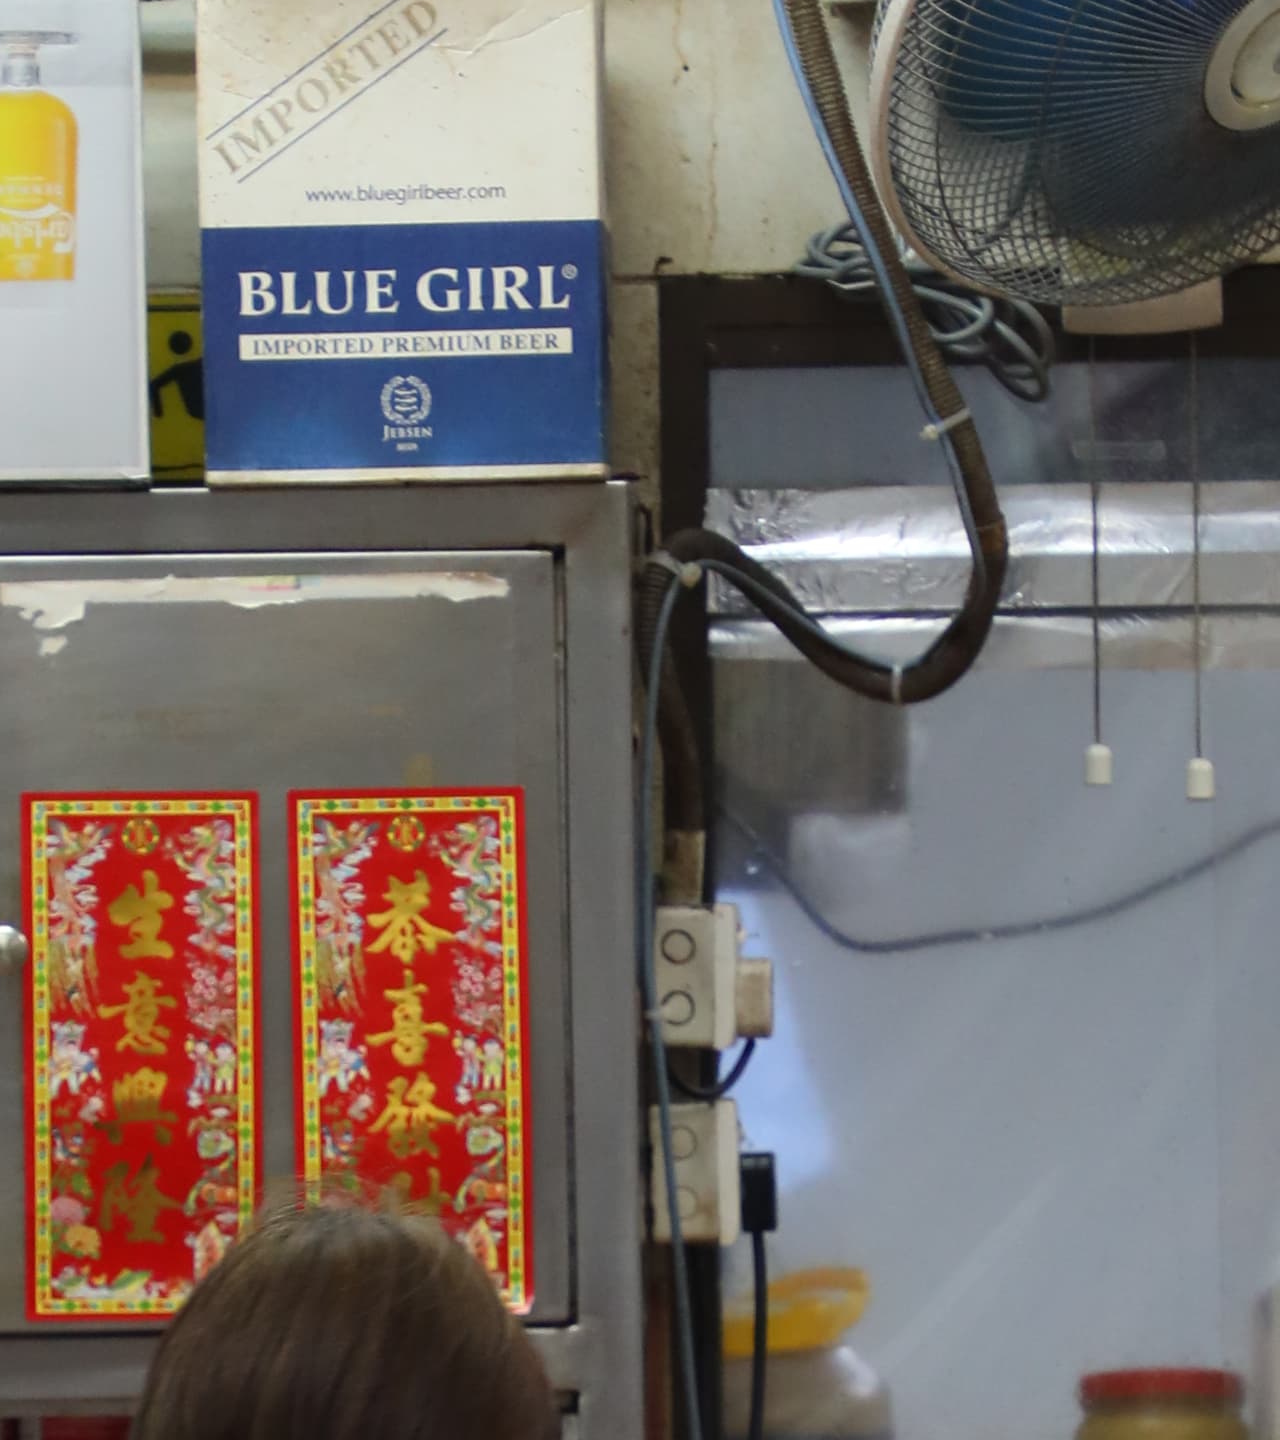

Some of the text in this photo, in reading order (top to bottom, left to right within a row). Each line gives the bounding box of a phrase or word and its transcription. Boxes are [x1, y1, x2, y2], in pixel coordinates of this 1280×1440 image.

[305, 184, 507, 206] www.bluegirlbeer.com
[238, 264, 572, 317] BLUE GIRL
[252, 332, 559, 357] IMPORTED PREMIUM BEER
[95, 869, 186, 1246] 生意興隆
